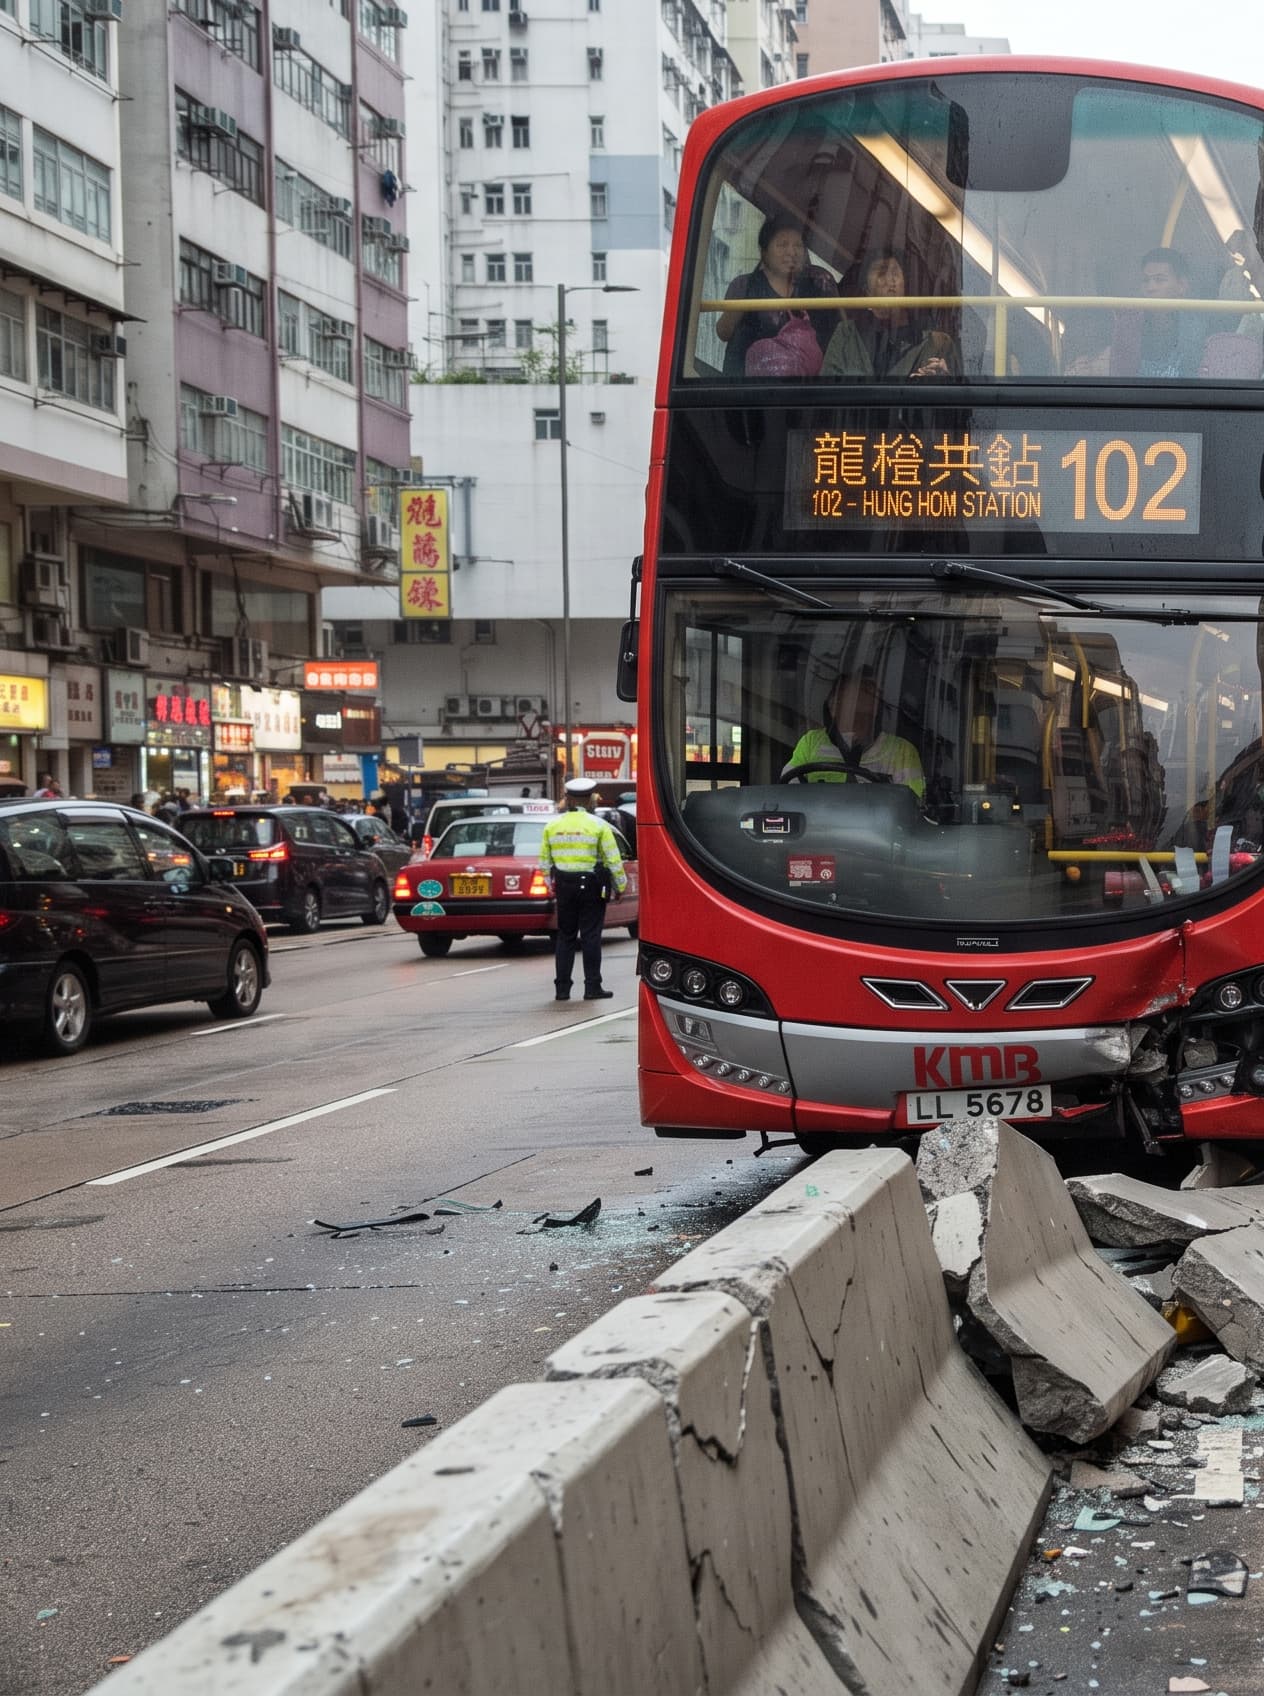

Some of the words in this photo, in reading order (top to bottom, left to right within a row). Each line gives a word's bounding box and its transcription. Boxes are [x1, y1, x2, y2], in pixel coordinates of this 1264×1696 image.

[1061, 439, 1187, 521] 102
[812, 489, 843, 517] 102
[863, 489, 913, 517] HUNG
[918, 490, 957, 517] HOM
[962, 490, 1042, 518] STATION
[914, 1045, 1042, 1088] KMB
[916, 1095, 954, 1120] LL
[966, 1089, 1044, 1118] 5678
